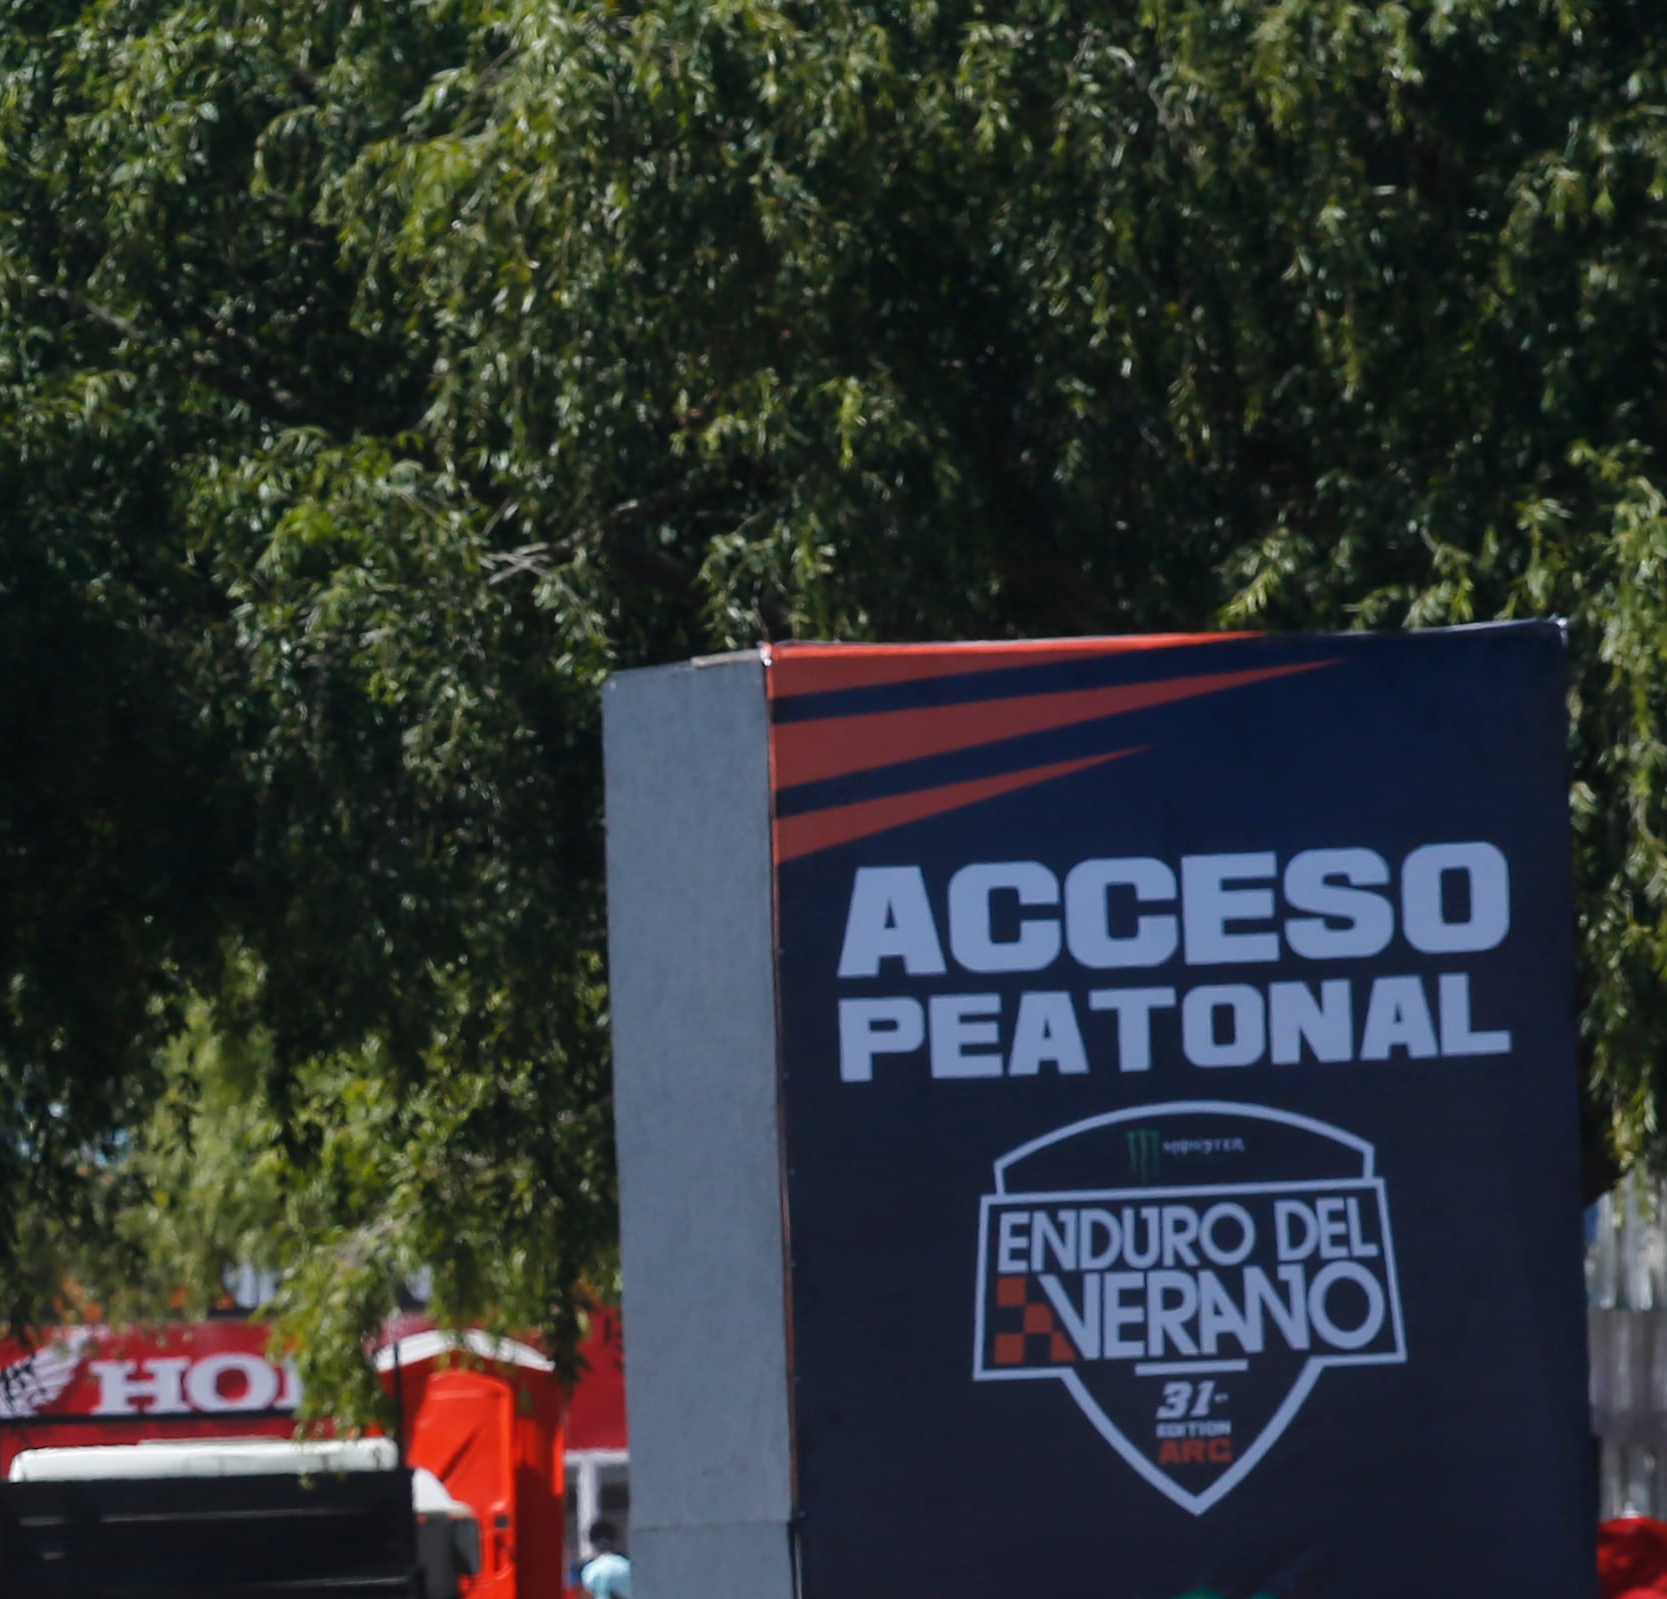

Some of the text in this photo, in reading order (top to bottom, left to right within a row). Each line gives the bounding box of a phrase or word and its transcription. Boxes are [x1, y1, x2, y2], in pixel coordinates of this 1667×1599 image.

[838, 841, 1510, 978] ACCESO
[839, 973, 1511, 1083] PEATONAL
[998, 1196, 1378, 1273] ENDURO DEL
[1038, 1259, 1386, 1361] VERANO
